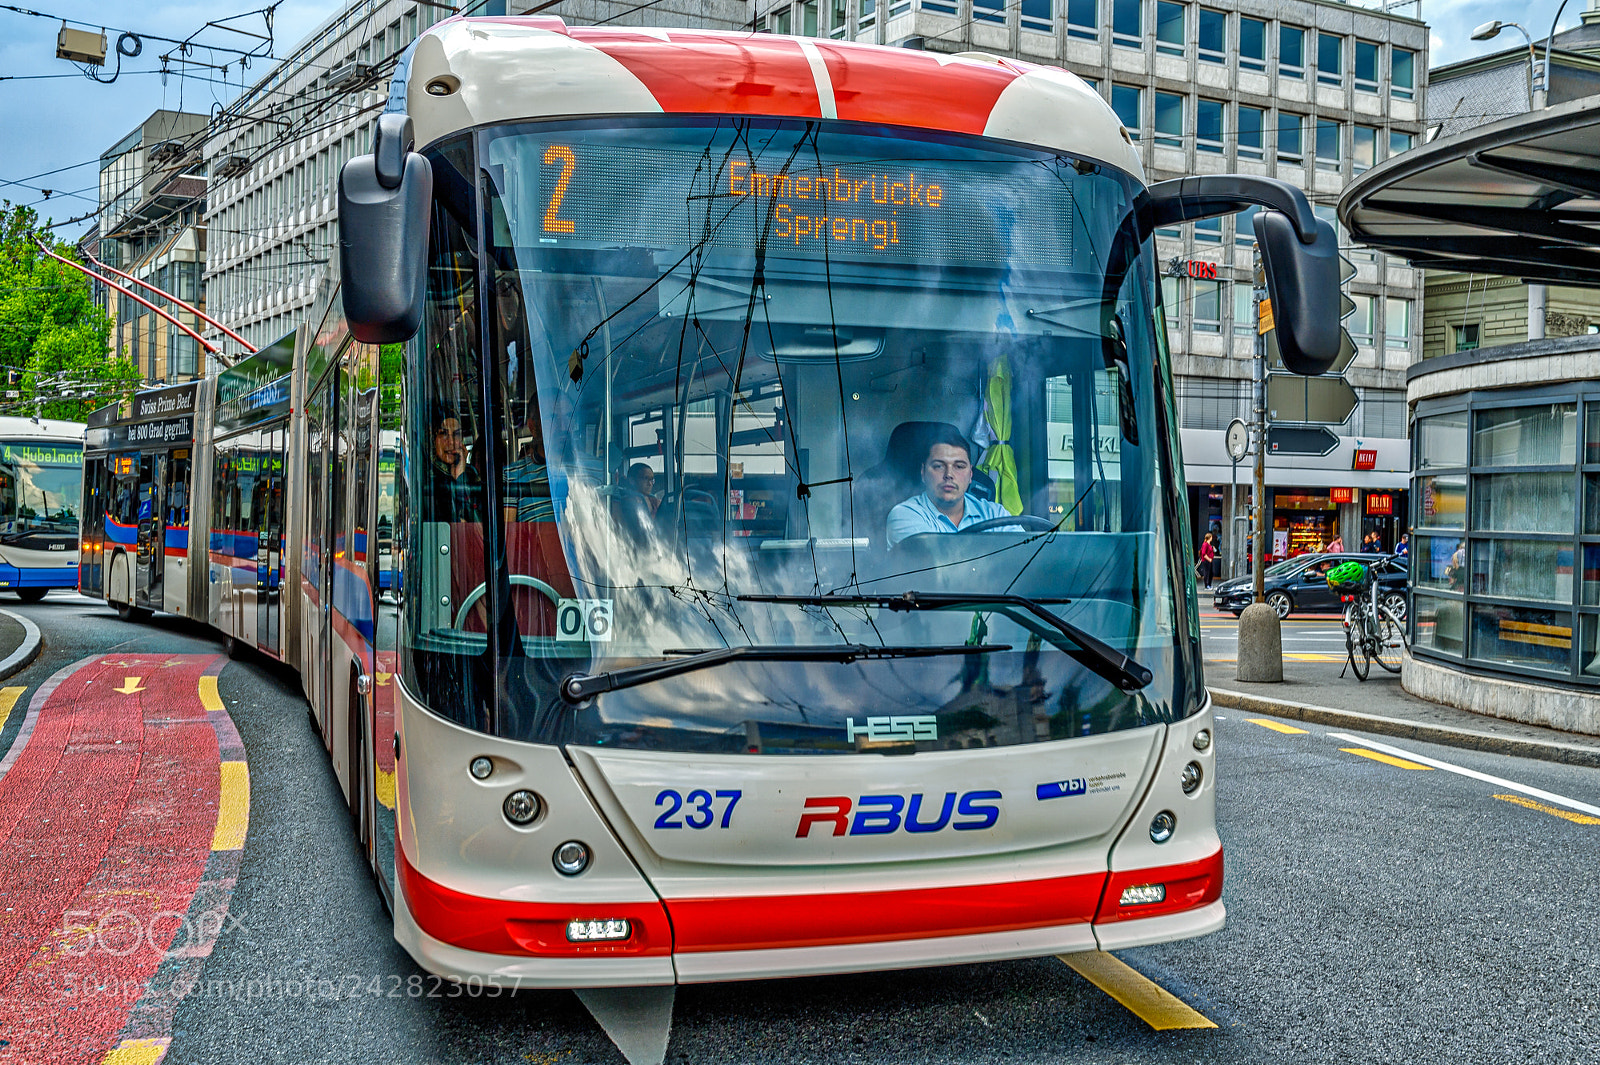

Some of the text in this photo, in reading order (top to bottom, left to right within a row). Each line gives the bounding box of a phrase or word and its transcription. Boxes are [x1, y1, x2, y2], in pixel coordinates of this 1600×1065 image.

[544, 145, 576, 234] 2
[729, 161, 943, 208] Emmenbrücke
[775, 203, 900, 250] Sprengi
[1188, 260, 1217, 280] UBS
[140, 391, 192, 416] Swiss Prime Beef.
[128, 418, 190, 441] bei 800 Grad gegrillt.
[4, 446, 11, 461] 4
[1371, 497, 1390, 508] HEINI
[560, 606, 609, 636] 06
[847, 715, 938, 743] HESS
[1058, 778, 1085, 793] vbl
[654, 790, 743, 829] 237
[795, 790, 1003, 838] RBUS
